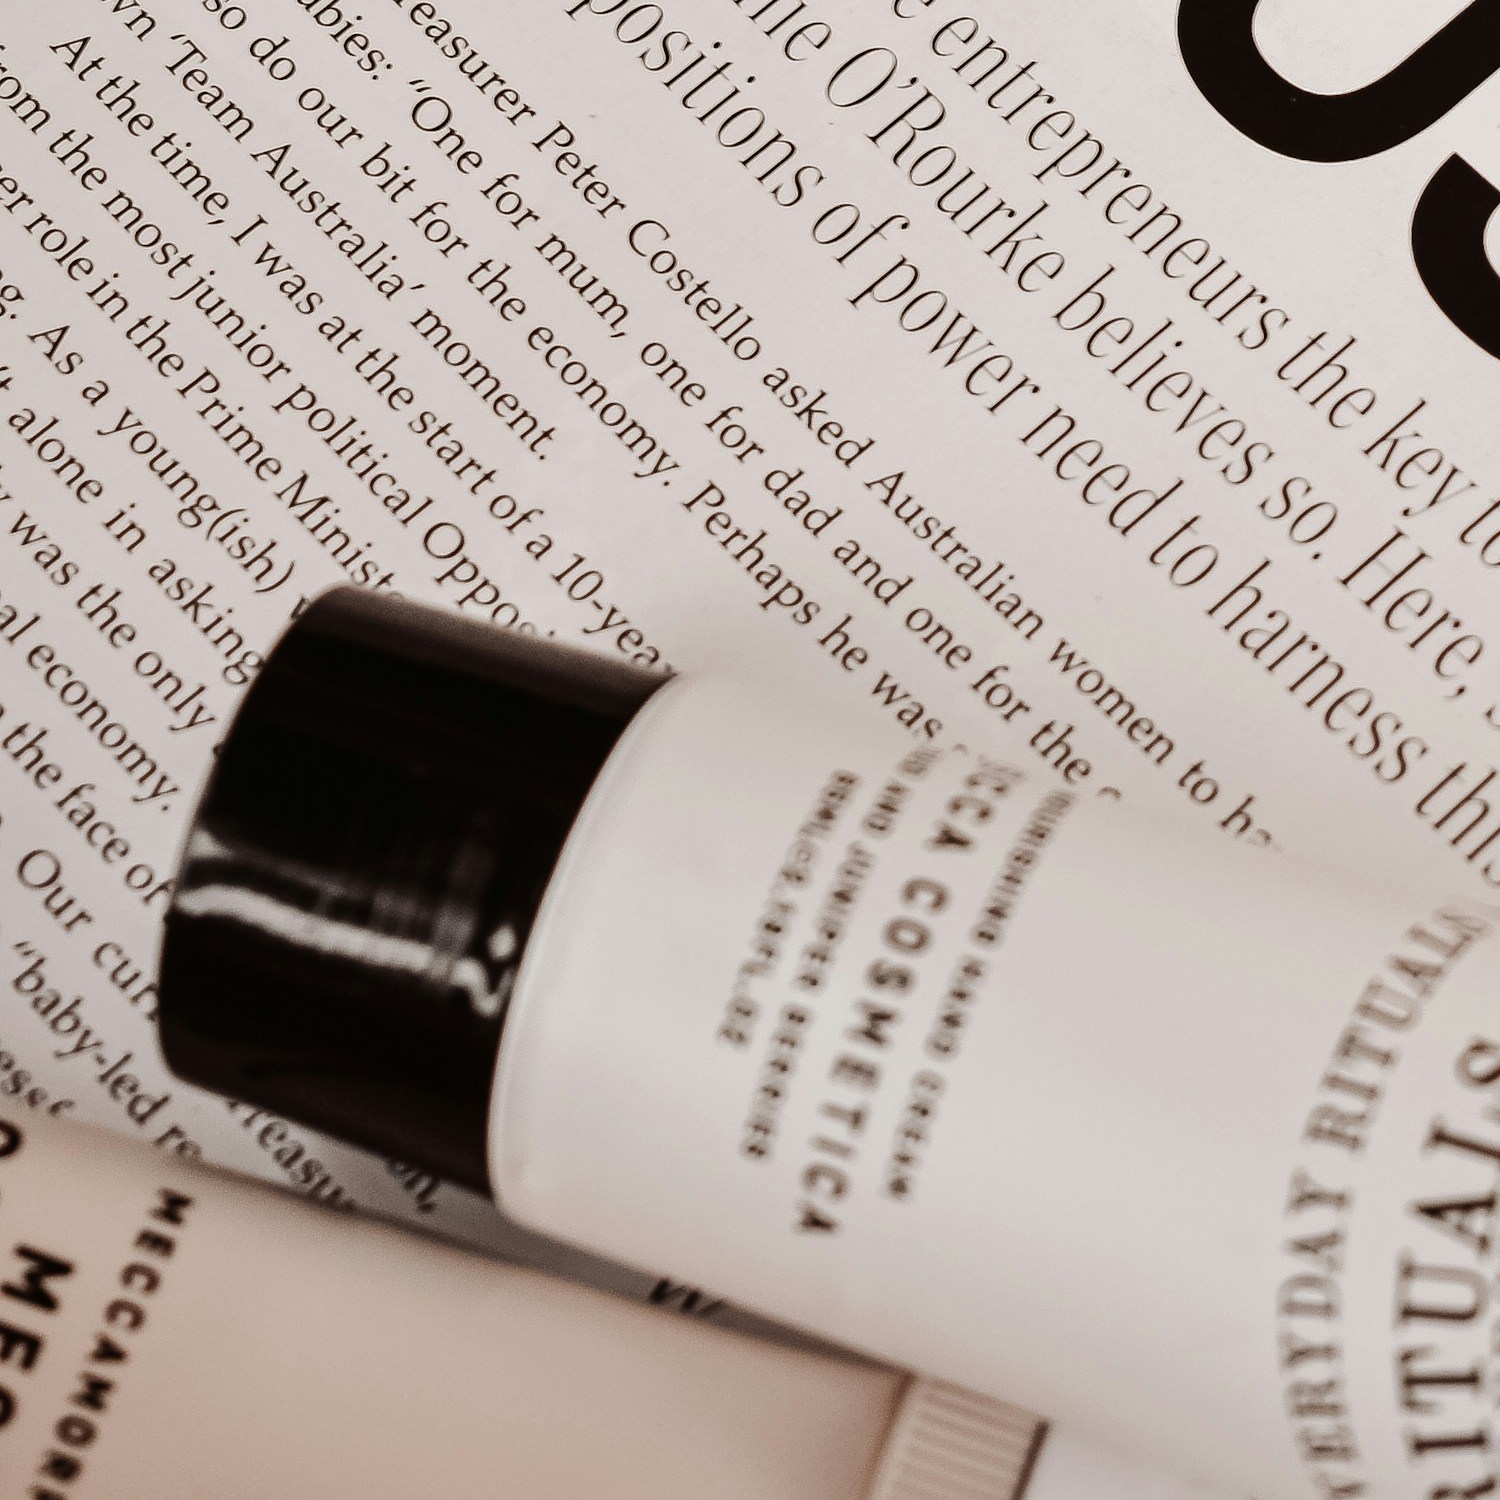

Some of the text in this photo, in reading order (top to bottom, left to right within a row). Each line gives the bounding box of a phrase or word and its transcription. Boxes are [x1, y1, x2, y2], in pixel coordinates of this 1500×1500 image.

[49, 129, 434, 528] the most junior political
[49, 37, 672, 673] At the time, I was at the start of a 10-yea
[811, 204, 910, 267] of
[846, 254, 1041, 416] power
[930, 17, 1291, 350] entrepreneurs
[1276, 332, 1376, 429] the
[1361, 398, 1477, 518] key
[23, 212, 404, 597] role in the Prime Minist
[27, 325, 295, 594] As a young(ish)
[249, 36, 296, 80] do
[298, 88, 364, 149] our
[360, 142, 417, 203] bit
[409, 201, 469, 258] for
[467, 259, 526, 321] the
[527, 327, 681, 486] economy.
[681, 480, 821, 625] Perhaps
[817, 613, 868, 672] he
[871, 671, 943, 741] was
[409, 308, 556, 460] moment.
[480, 174, 540, 231] for
[534, 233, 629, 338] mum,
[639, 342, 706, 407] one
[704, 406, 765, 464] for
[762, 468, 844, 538] dad
[832, 540, 915, 607] and
[905, 608, 972, 670] one
[970, 666, 1032, 723] for
[1029, 720, 1092, 785] the
[531, 121, 627, 219] Peter
[627, 219, 761, 360] Costello
[762, 367, 876, 468] asked
[864, 471, 1043, 640] Australian
[1049, 638, 1175, 766] women
[1178, 760, 1220, 805] to
[1019, 405, 1184, 537] need
[1051, 264, 1275, 485] believes
[1257, 477, 1338, 561] so.
[1337, 526, 1484, 699] Here,
[8, 408, 261, 686] alone in asking
[9, 510, 215, 733] was the only
[1149, 515, 1219, 588] to
[1205, 557, 1429, 783] harness
[1, 723, 63, 790] the
[54, 783, 130, 864] face
[26, 644, 179, 812] economy.
[16, 849, 93, 934] Our
[793, 876, 950, 1236] COSMETICA
[1276, 1163, 1366, 1500] VERYDAY
